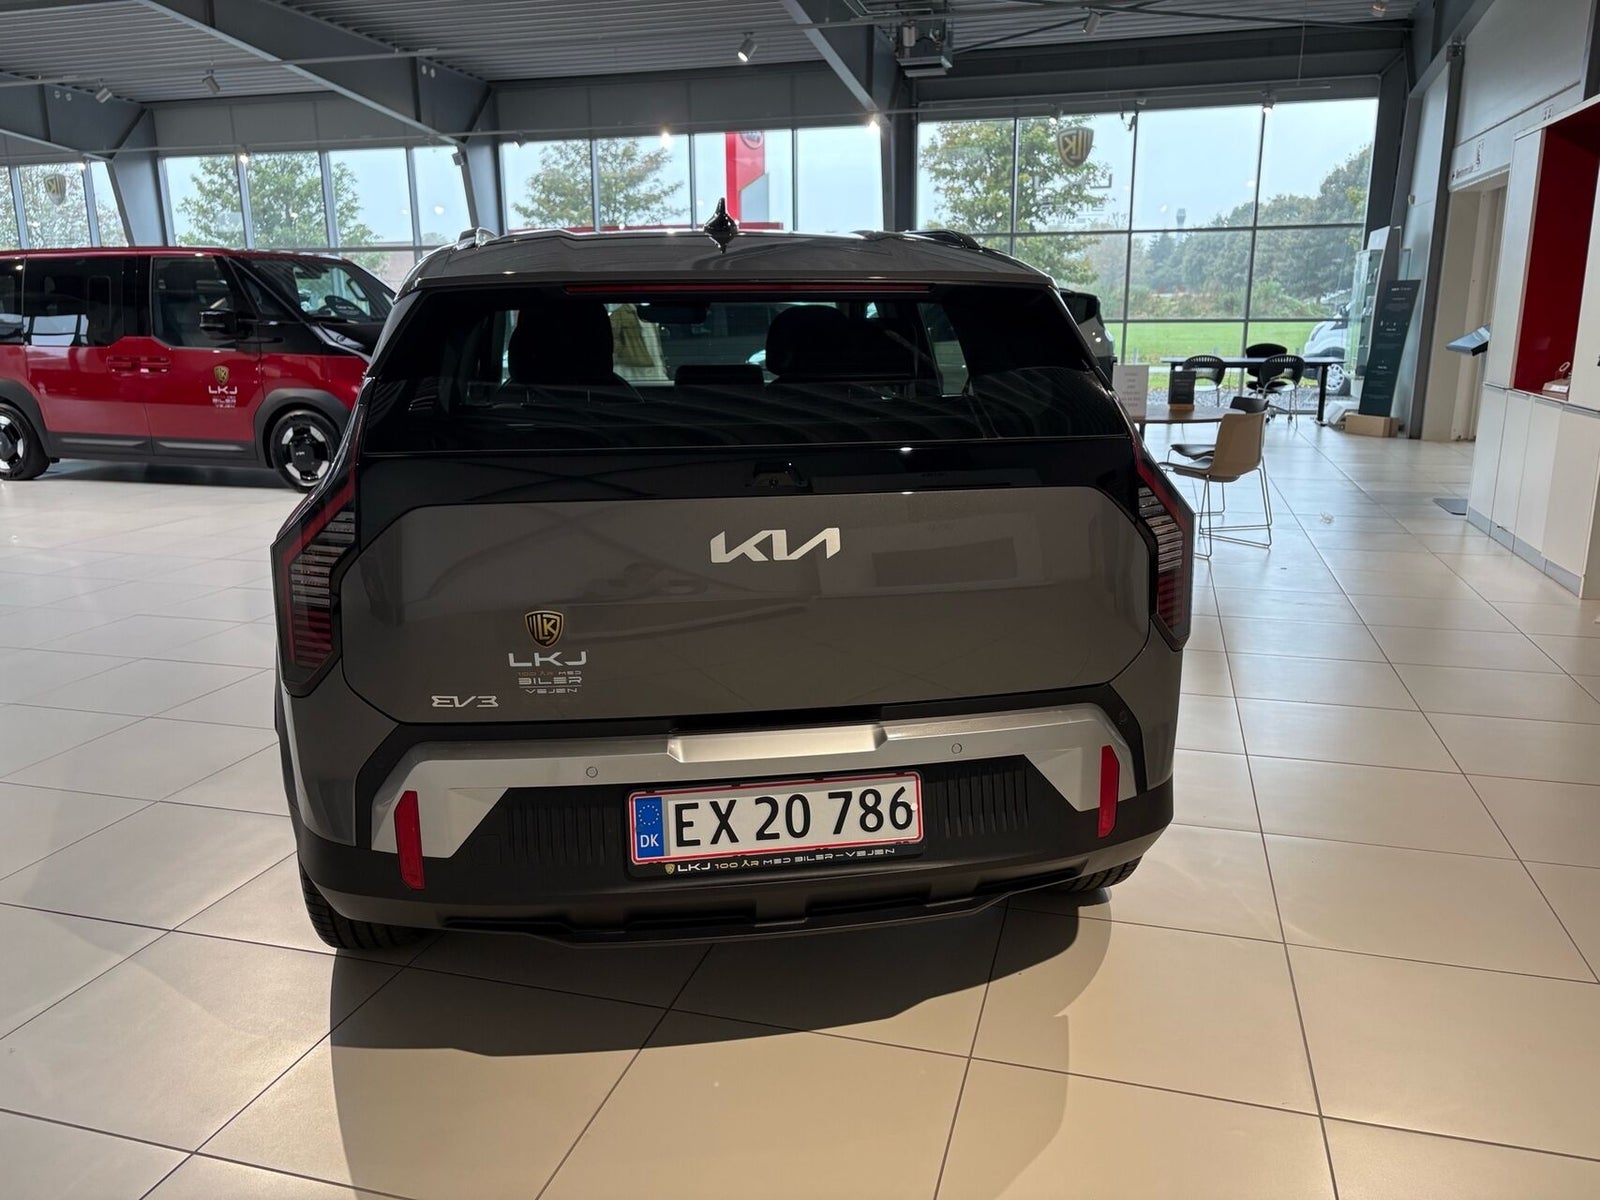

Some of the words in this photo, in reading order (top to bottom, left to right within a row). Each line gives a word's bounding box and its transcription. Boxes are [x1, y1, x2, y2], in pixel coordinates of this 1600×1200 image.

[208, 385, 238, 394] LKJ
[710, 527, 841, 563] KIA
[508, 651, 587, 667] LKJ
[518, 676, 582, 685] BILER
[431, 695, 499, 708] EV3
[674, 798, 740, 847] EX
[754, 793, 811, 841] 20
[828, 786, 914, 835] 786
[640, 834, 659, 848] DK
[677, 862, 711, 872] LKJ
[714, 862, 739, 870] 100
[763, 857, 791, 865] MED
